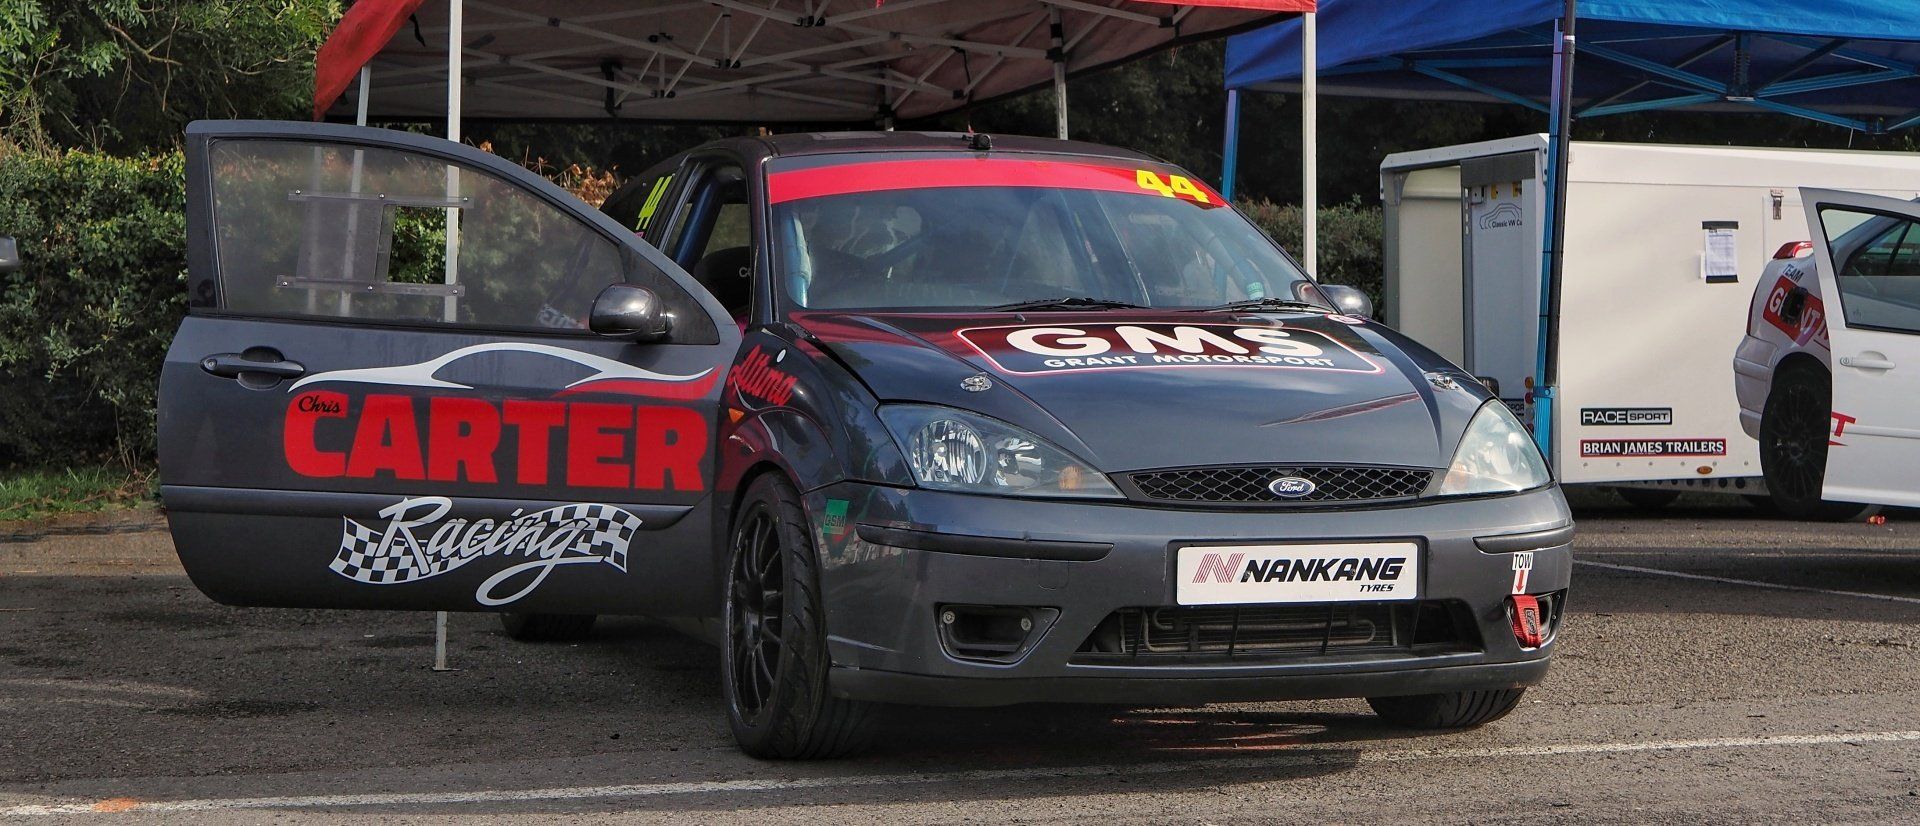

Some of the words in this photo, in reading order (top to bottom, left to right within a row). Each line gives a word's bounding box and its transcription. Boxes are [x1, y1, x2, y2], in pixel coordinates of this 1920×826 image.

[1136, 169, 1211, 204] 44
[1491, 220, 1508, 229] Classic
[1508, 219, 1516, 227] VW
[1783, 263, 1805, 283] TEAM
[1006, 325, 1324, 357] GMS
[1044, 354, 1138, 368] GRANT
[1152, 353, 1335, 367] MOTORSPORT
[298, 394, 342, 413] Chris
[1582, 411, 1627, 423] RACE
[1629, 412, 1669, 421] SPORT
[283, 390, 709, 491] CARTER
[1583, 442, 1621, 454] BRIAN
[1622, 441, 1663, 455] JAMES
[1666, 440, 1725, 453] TRAILERS
[1279, 480, 1305, 492] Ford
[375, 496, 604, 607] Racing
[1512, 553, 1534, 569] TOW
[1240, 556, 1407, 584] NANKANG
[1359, 583, 1395, 593] TYRES
